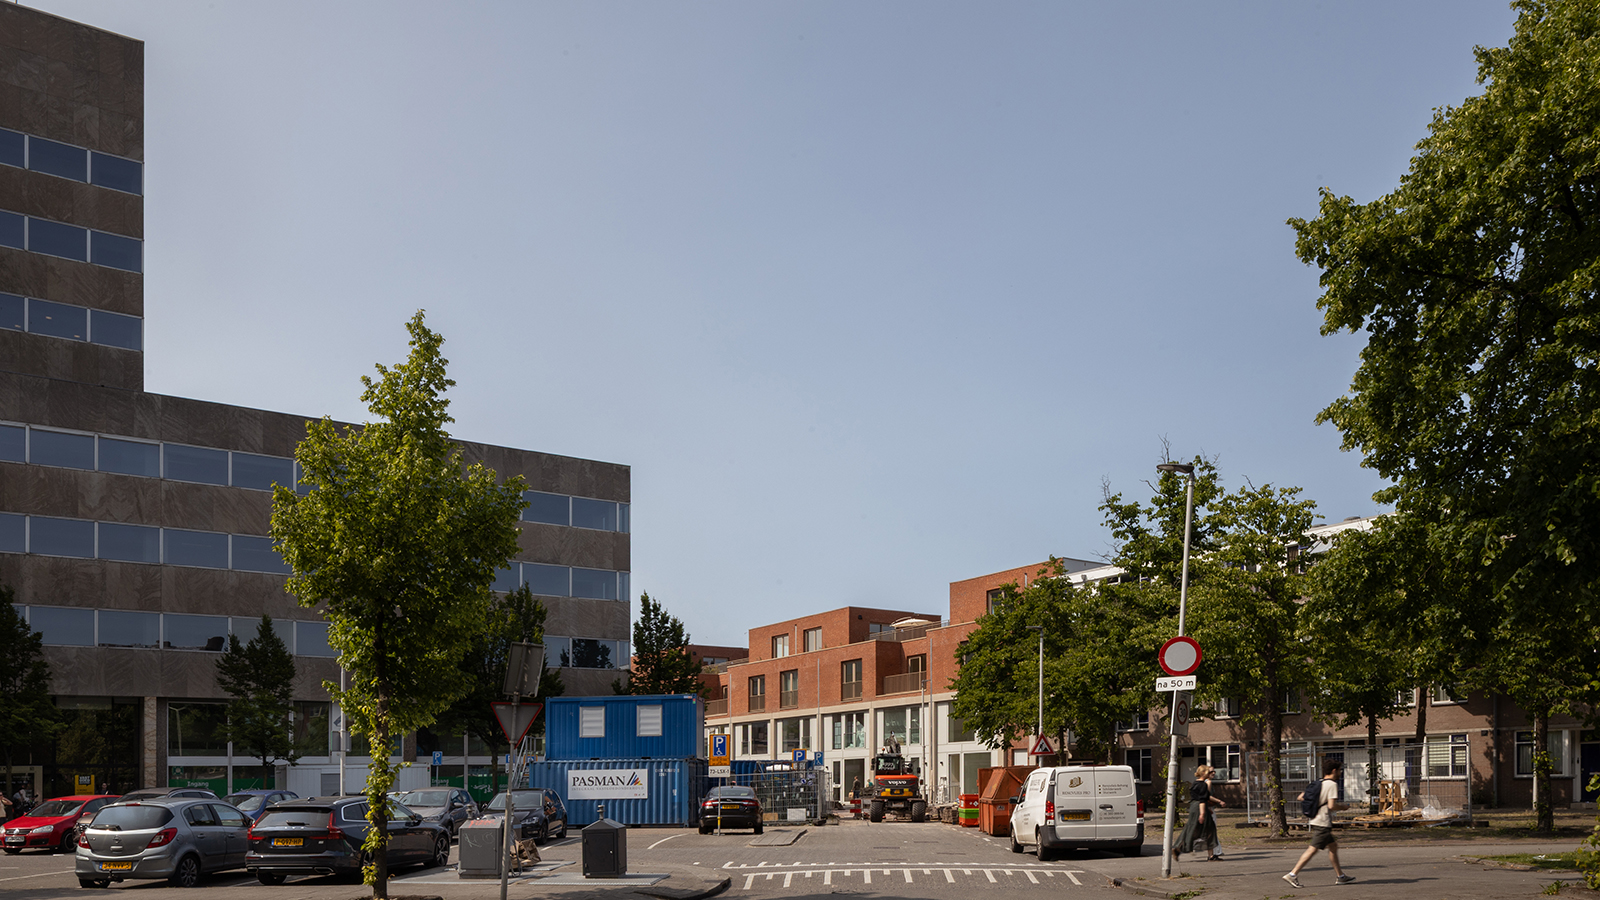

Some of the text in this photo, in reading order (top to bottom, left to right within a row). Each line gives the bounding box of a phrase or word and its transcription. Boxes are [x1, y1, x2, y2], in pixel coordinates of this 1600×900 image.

[716, 737, 723, 748] P
[435, 752, 440, 760] P
[796, 751, 803, 761] P
[816, 753, 821, 761] P
[572, 776, 625, 786] PASMAN
